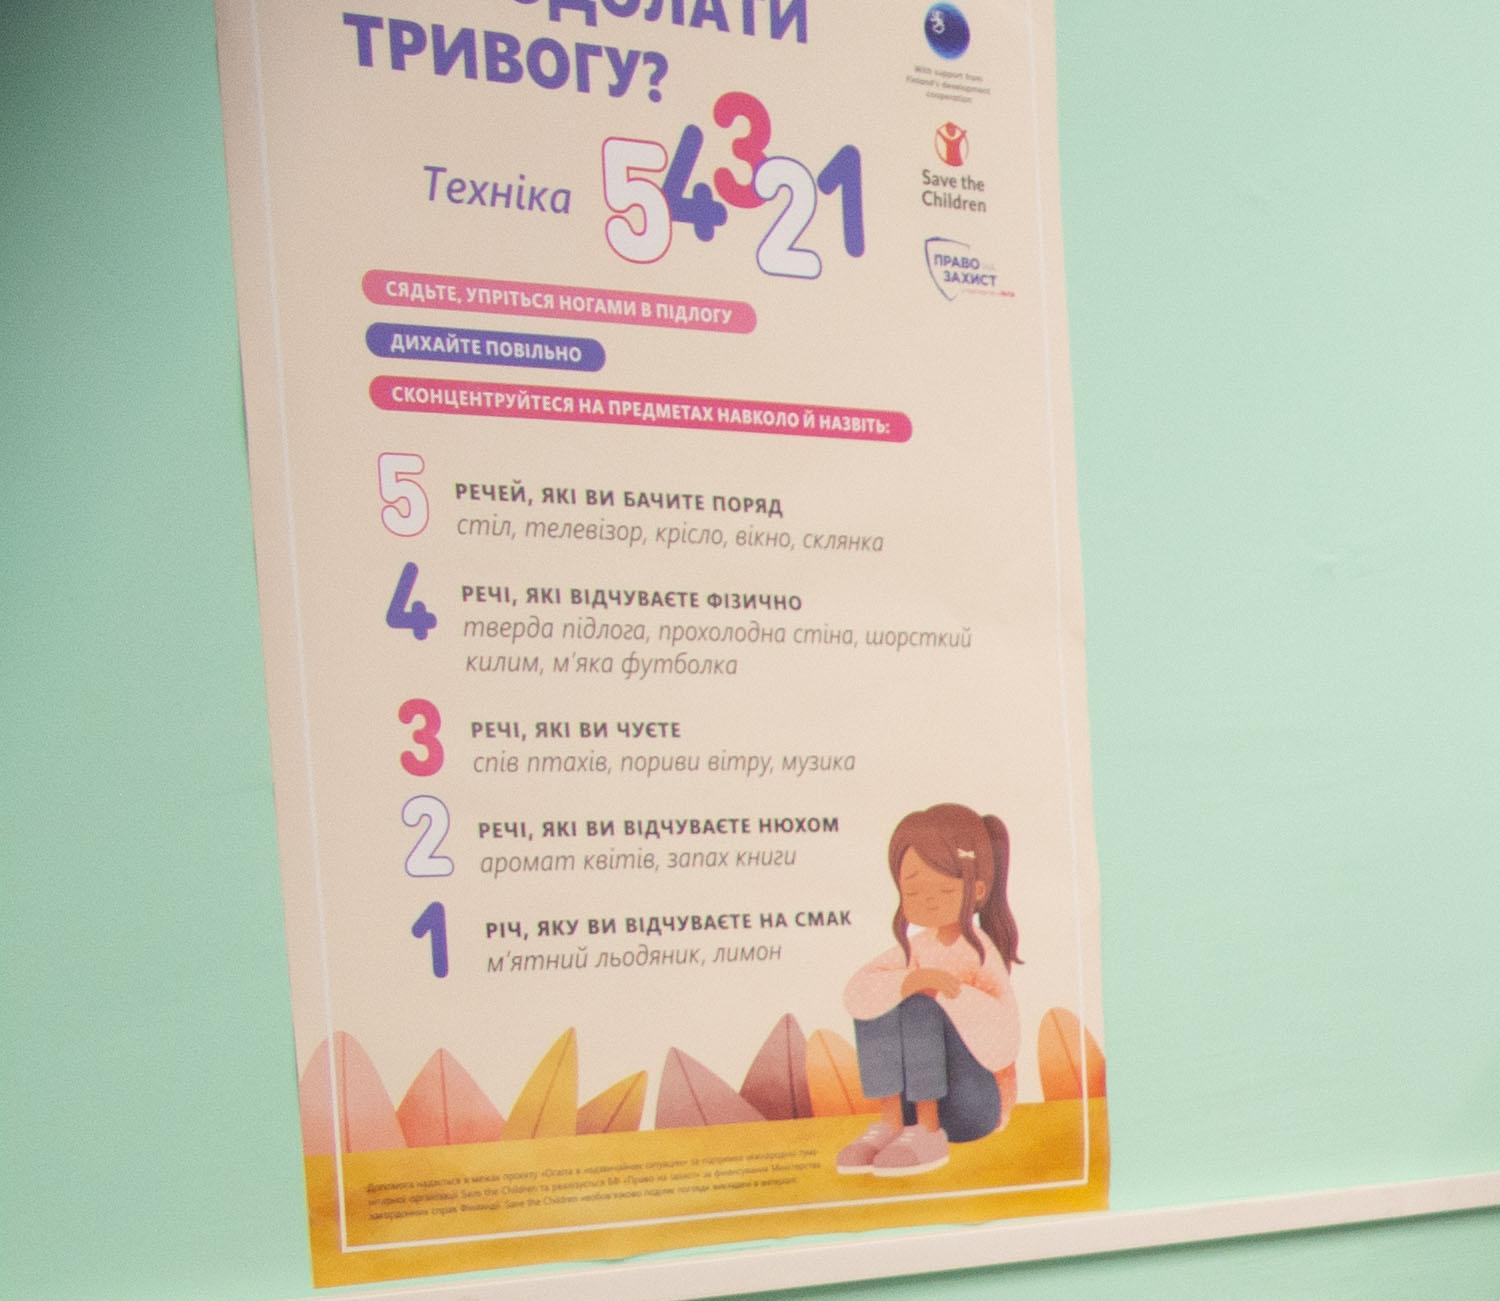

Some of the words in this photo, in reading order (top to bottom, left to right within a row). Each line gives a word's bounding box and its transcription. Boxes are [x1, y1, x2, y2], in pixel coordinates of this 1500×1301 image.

[342, 12, 669, 103] ТРИВОГУ?
[422, 165, 573, 215] Техніка
[922, 168, 957, 188] Save
[961, 175, 985, 192] the
[922, 189, 987, 213] Children
[933, 253, 980, 270] ПРАВО
[943, 270, 997, 287] ЗАХИСТ
[385, 280, 463, 304] СЯДЬТЕ,
[466, 286, 556, 309] УПРІТЬСЯ
[559, 293, 637, 316] НОГАМИ
[641, 301, 651, 318] В
[656, 302, 733, 326] ПІДЛОГУ
[390, 332, 481, 356] ДИХАЙТЕ
[486, 340, 582, 363] ПОВІЛЬНО
[391, 385, 574, 414] СКОНЦЕНТРУЙТЕСЯ
[579, 398, 604, 415] НА
[608, 400, 714, 424] ПРЕДМЕТАХ
[718, 407, 798, 429] НАВКОЛО
[803, 407, 815, 429] Й
[819, 414, 890, 436] НАЗВІТЬ:
[378, 452, 429, 537] 5
[455, 481, 533, 506] РЕЧЕЙ,
[542, 487, 576, 506] ЯКІ
[586, 488, 615, 507] ВИ
[623, 490, 705, 512] БАЧИТЕ
[712, 495, 784, 518] ПОРЯД
[456, 515, 517, 541] стіл,
[525, 519, 648, 548] телевізор,
[655, 524, 728, 549] крісло,
[735, 525, 796, 551] вікно,
[802, 531, 884, 553] склянка
[386, 562, 437, 640] 4
[461, 584, 518, 607] РЕЧІ,
[526, 587, 561, 606] ЯКІ
[570, 588, 699, 611] ВІДЧУВАЄТЕ
[706, 592, 803, 612] ФІЗИЧНО
[463, 615, 554, 646] тверда
[562, 615, 651, 644] підлога,
[658, 619, 787, 648] прохолодна
[793, 624, 858, 648] стіна,
[865, 626, 973, 652] шорсткий
[465, 652, 545, 677] килим,
[621, 650, 738, 682] футболка
[398, 698, 444, 777] 3
[471, 721, 527, 742] РЕЧІ,
[535, 722, 570, 739] ЯКІ
[579, 721, 608, 738] ВИ
[616, 721, 681, 739] ЧУЄТЕ
[473, 751, 519, 774] спів
[527, 752, 613, 776] птахів,
[620, 755, 700, 777] пориви
[707, 749, 774, 776] вітру,
[781, 753, 856, 776] музика
[401, 794, 454, 877] 2
[478, 821, 533, 842] РЕЧІ,
[542, 820, 577, 838] ЯКІ
[586, 819, 615, 837] ВИ
[624, 818, 751, 840] ВІДЧУВАЄТЕ
[758, 816, 839, 834] НЮХОМ
[480, 855, 576, 879] аромат
[583, 847, 660, 874] квітів,
[667, 851, 728, 871] запах
[735, 848, 796, 868] книги
[411, 901, 449, 979] 1
[486, 920, 530, 942] РІЧ,
[537, 919, 579, 938] ЯКУ
[588, 918, 617, 936] ВИ
[626, 914, 752, 940] ВІДЧУВАЄТЕ
[759, 912, 788, 930] НА
[795, 909, 852, 928] СМАК
[595, 942, 706, 968] льодяник,
[713, 945, 782, 964] лимон
